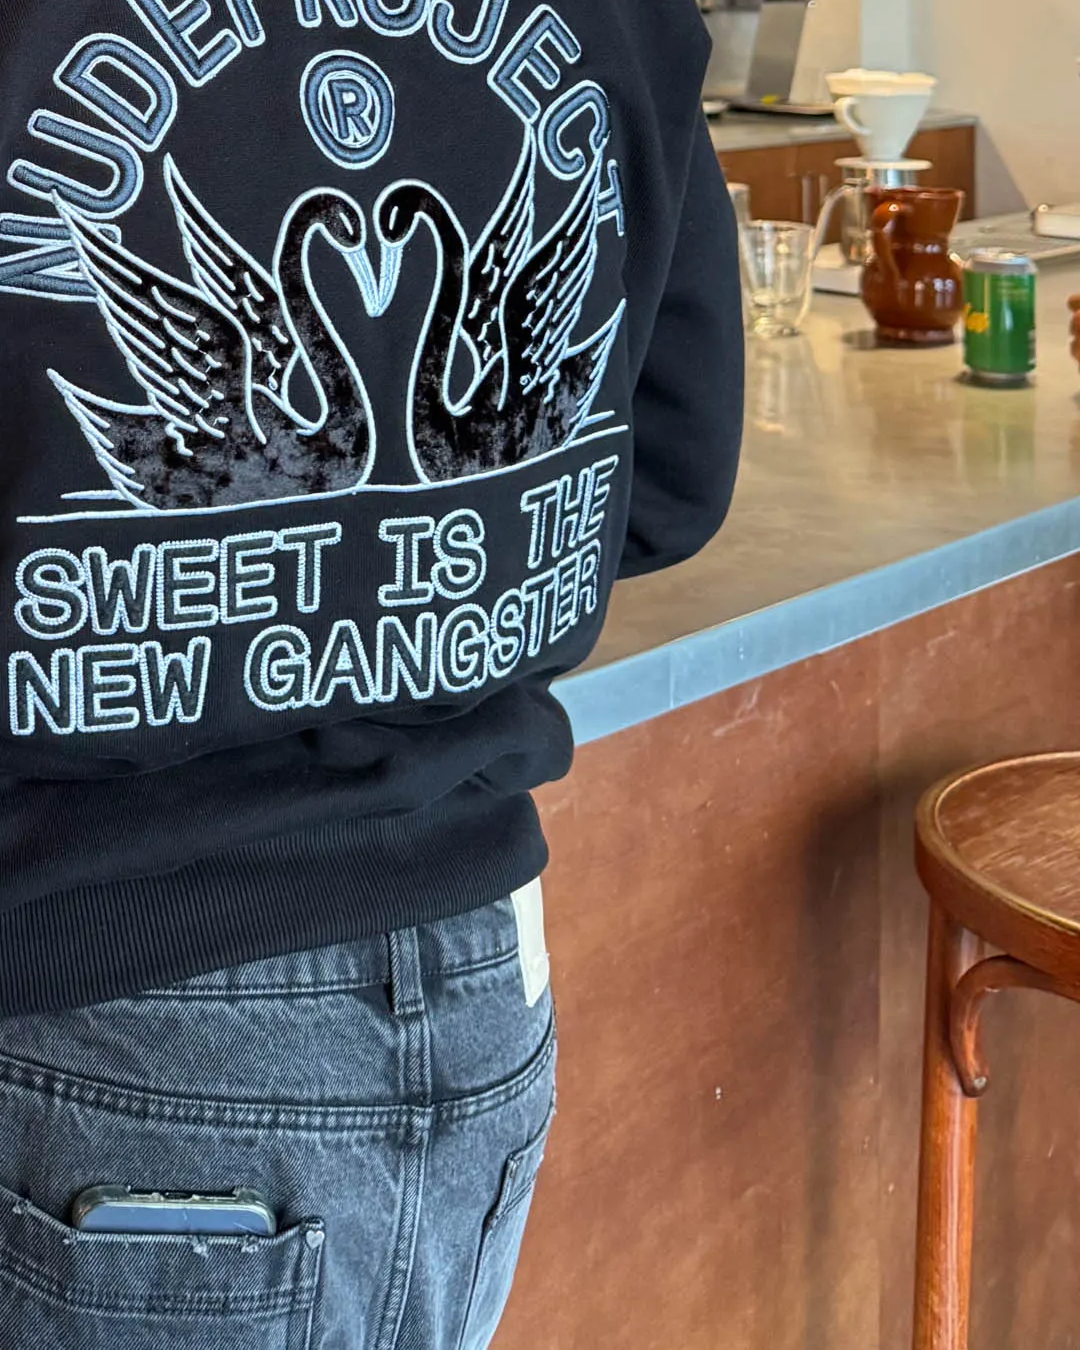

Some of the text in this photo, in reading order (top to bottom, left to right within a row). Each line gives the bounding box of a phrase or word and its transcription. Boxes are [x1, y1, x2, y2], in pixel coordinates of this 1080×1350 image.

[8, 539, 601, 736] NEW GANGSTER
[14, 455, 619, 640] SWEET IS THE
